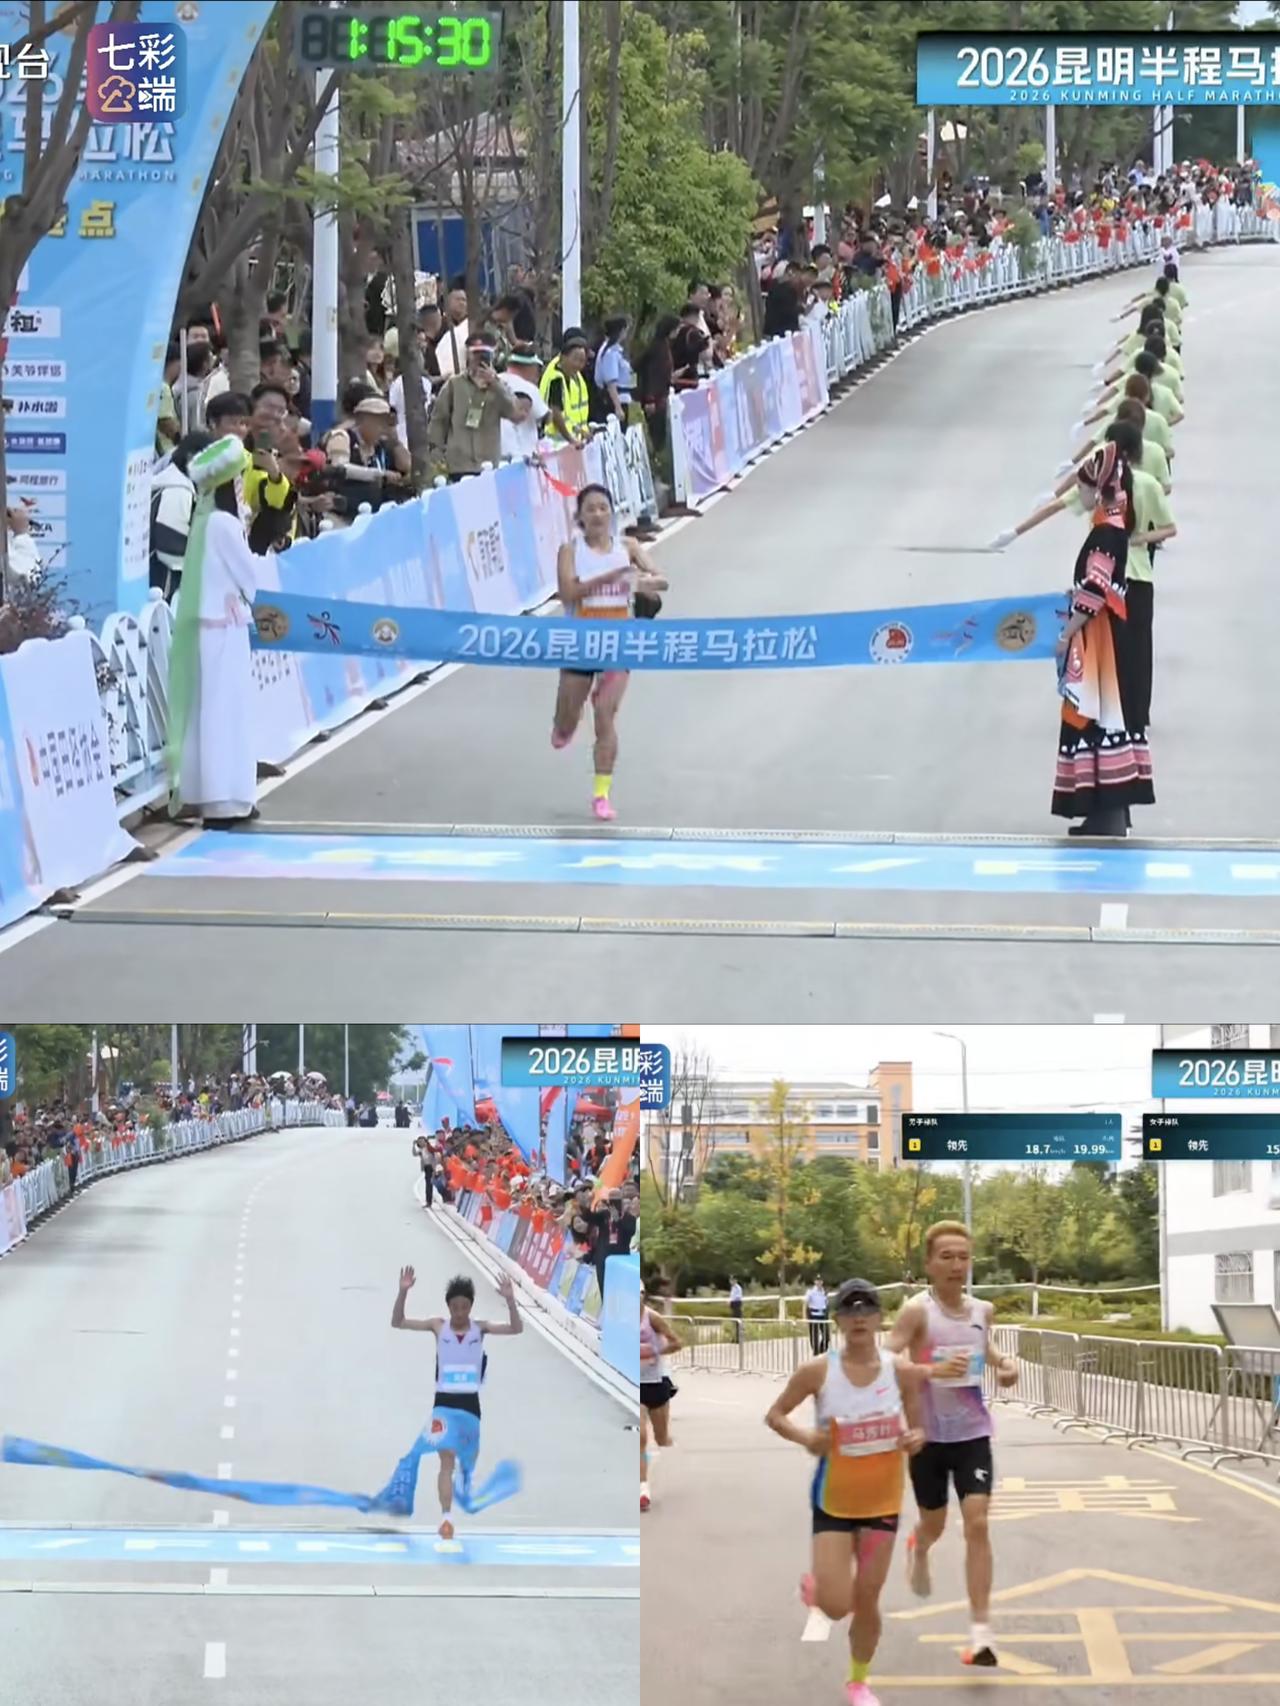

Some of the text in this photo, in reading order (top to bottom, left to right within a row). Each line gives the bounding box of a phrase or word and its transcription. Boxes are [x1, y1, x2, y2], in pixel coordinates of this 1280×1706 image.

[350, 15, 490, 66] 1:15:30
[458, 624, 817, 663] 2026昆明半程马拉松
